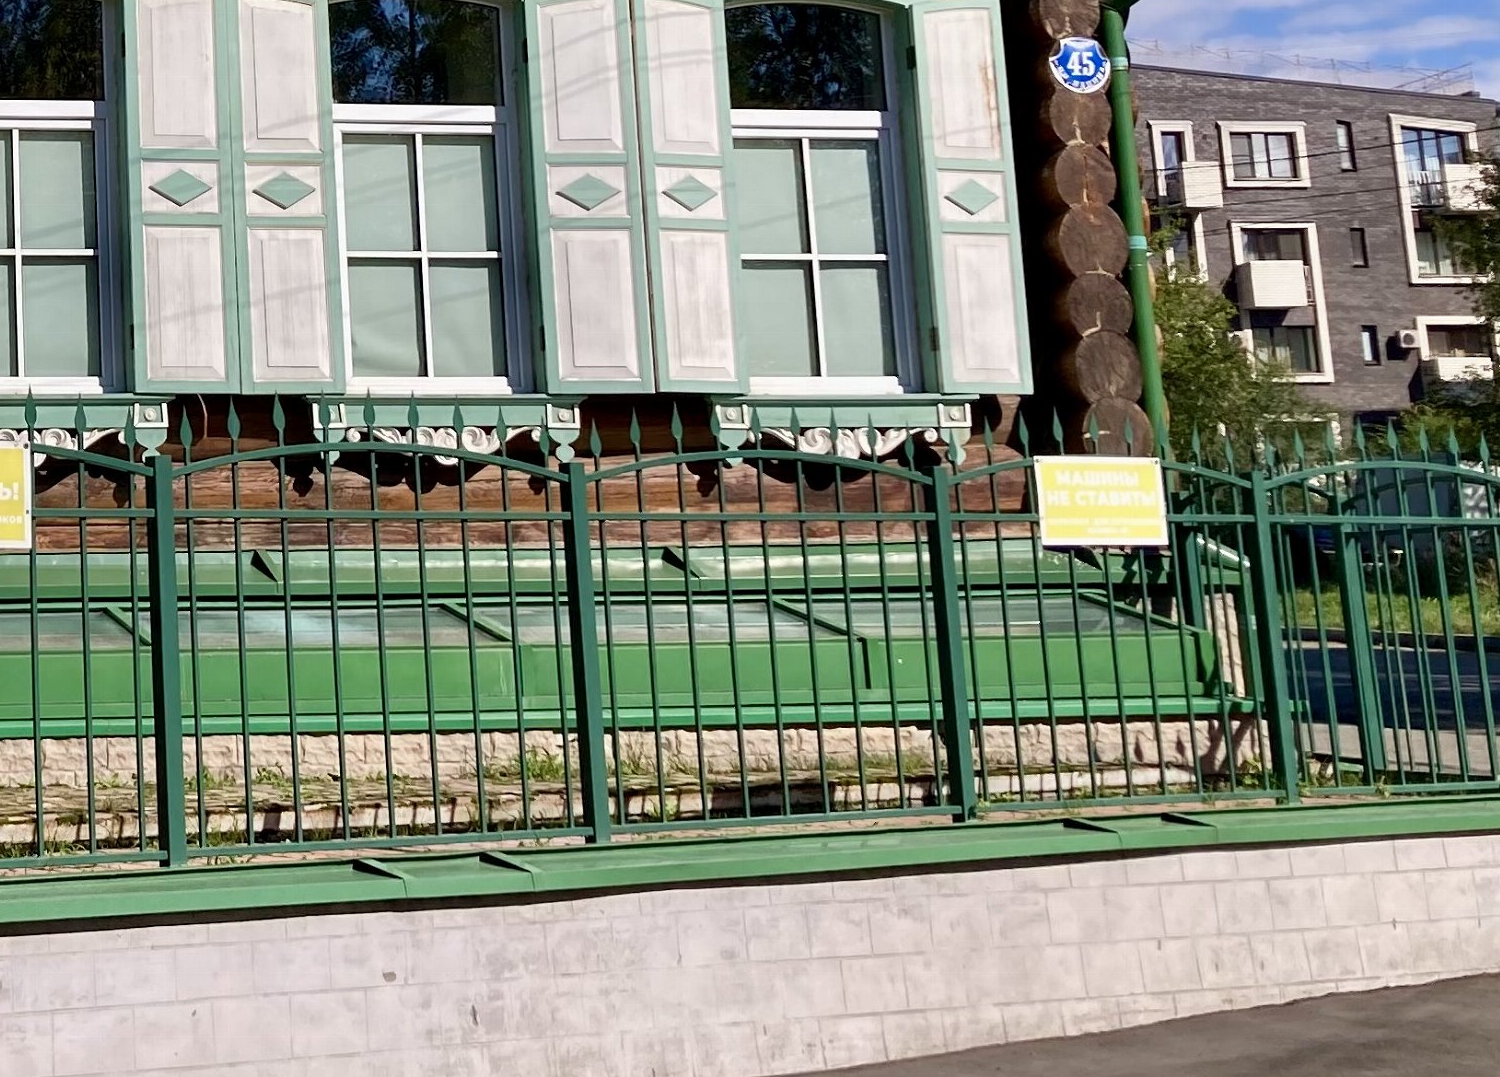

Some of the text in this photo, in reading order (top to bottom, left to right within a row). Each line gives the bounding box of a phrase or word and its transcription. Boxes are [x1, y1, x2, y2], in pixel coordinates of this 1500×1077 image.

[1066, 51, 1096, 76] 45
[1056, 470, 1139, 486] МАШИНЫ
[1046, 490, 1069, 506] НЕ
